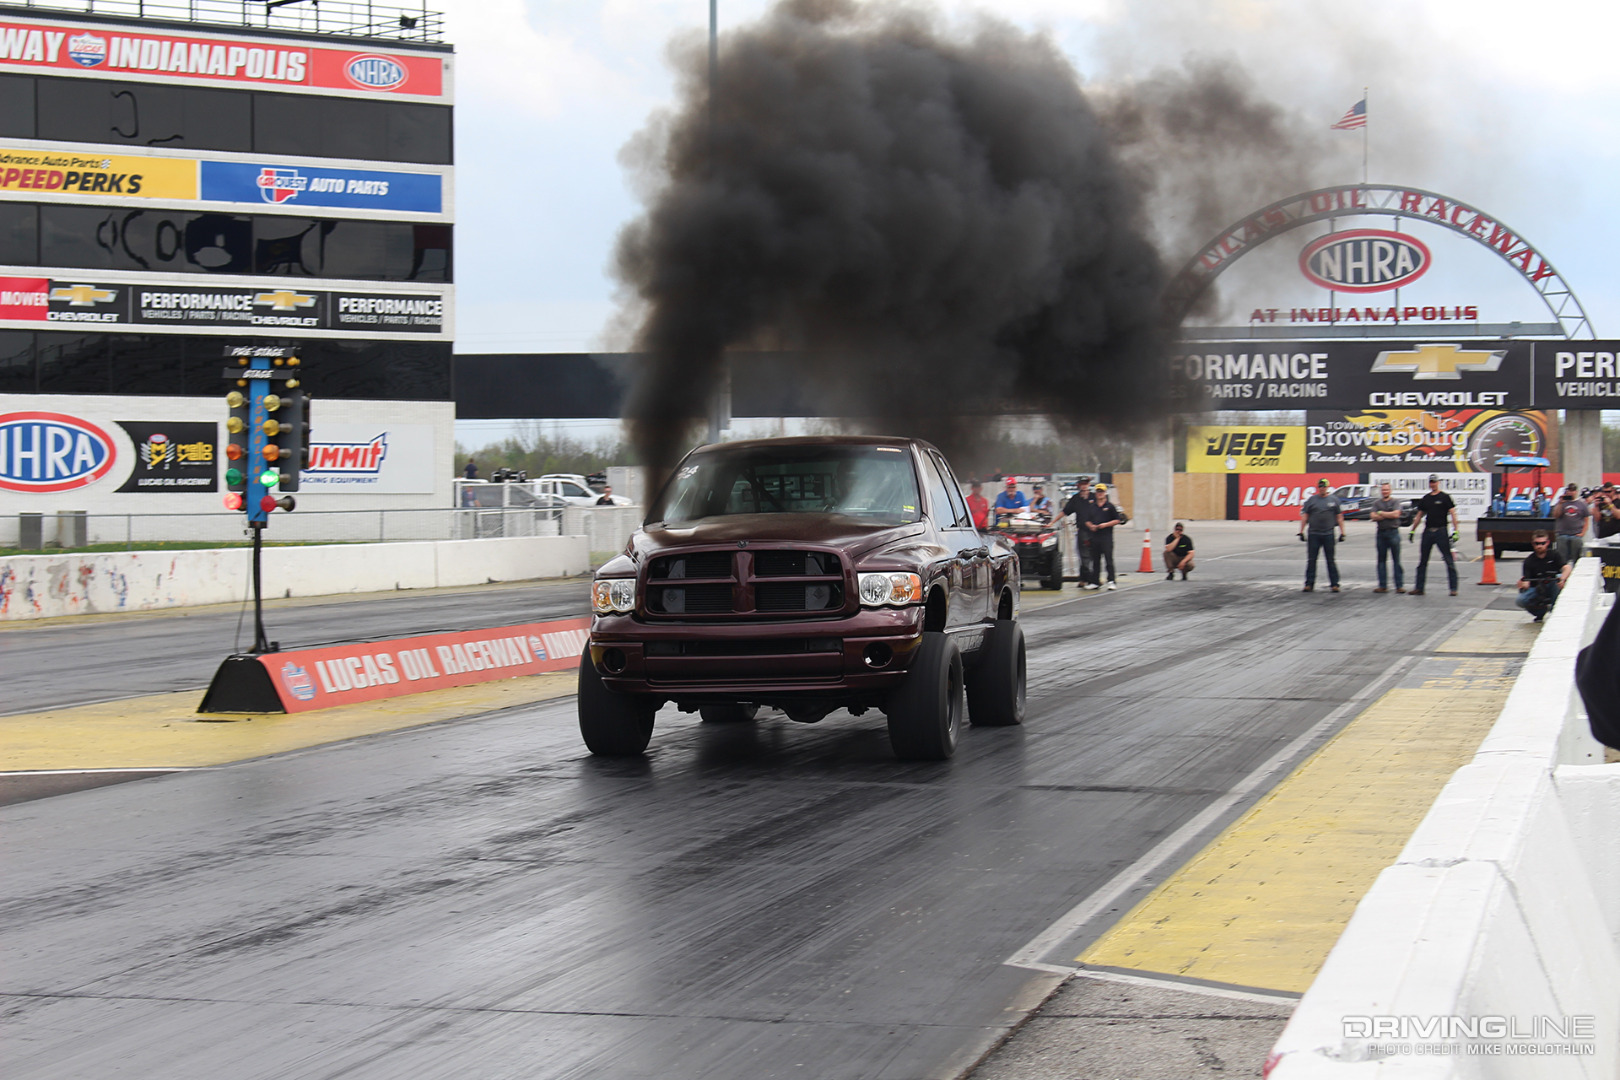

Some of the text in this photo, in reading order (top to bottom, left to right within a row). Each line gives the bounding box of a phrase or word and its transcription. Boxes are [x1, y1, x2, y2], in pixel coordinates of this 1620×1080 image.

[108, 36, 307, 82] INDIANAPOLIS
[353, 60, 401, 84] NHRA
[41, 156, 69, 167] Auto
[70, 157, 100, 169] Parts
[309, 177, 345, 193] AUTO
[346, 179, 389, 195] PARTS
[1310, 188, 1366, 213] OIL
[1400, 191, 1555, 282] RACEWAY
[1320, 240, 1415, 284] NHRA
[1, 291, 49, 306] MOWER
[141, 292, 253, 310] PERFORMANCE
[339, 297, 443, 316] PERFORMANCE
[46, 311, 119, 322] CHEVROLET
[251, 315, 319, 327] CHEVROLET
[1250, 305, 1478, 323] AT INDIANAPOLIS
[1205, 383, 1253, 398] PARTS
[1267, 382, 1328, 398] RACING
[1369, 391, 1509, 406] CHEVROLET
[1326, 421, 1386, 430] TOWN OF
[1206, 433, 1287, 456] JEGS
[1307, 425, 1470, 451] Brownsburg
[1308, 451, 1473, 465] Racing is our business!
[314, 652, 400, 693] LUCAS
[397, 648, 440, 682] OIL
[435, 635, 533, 675] RACEWAY
